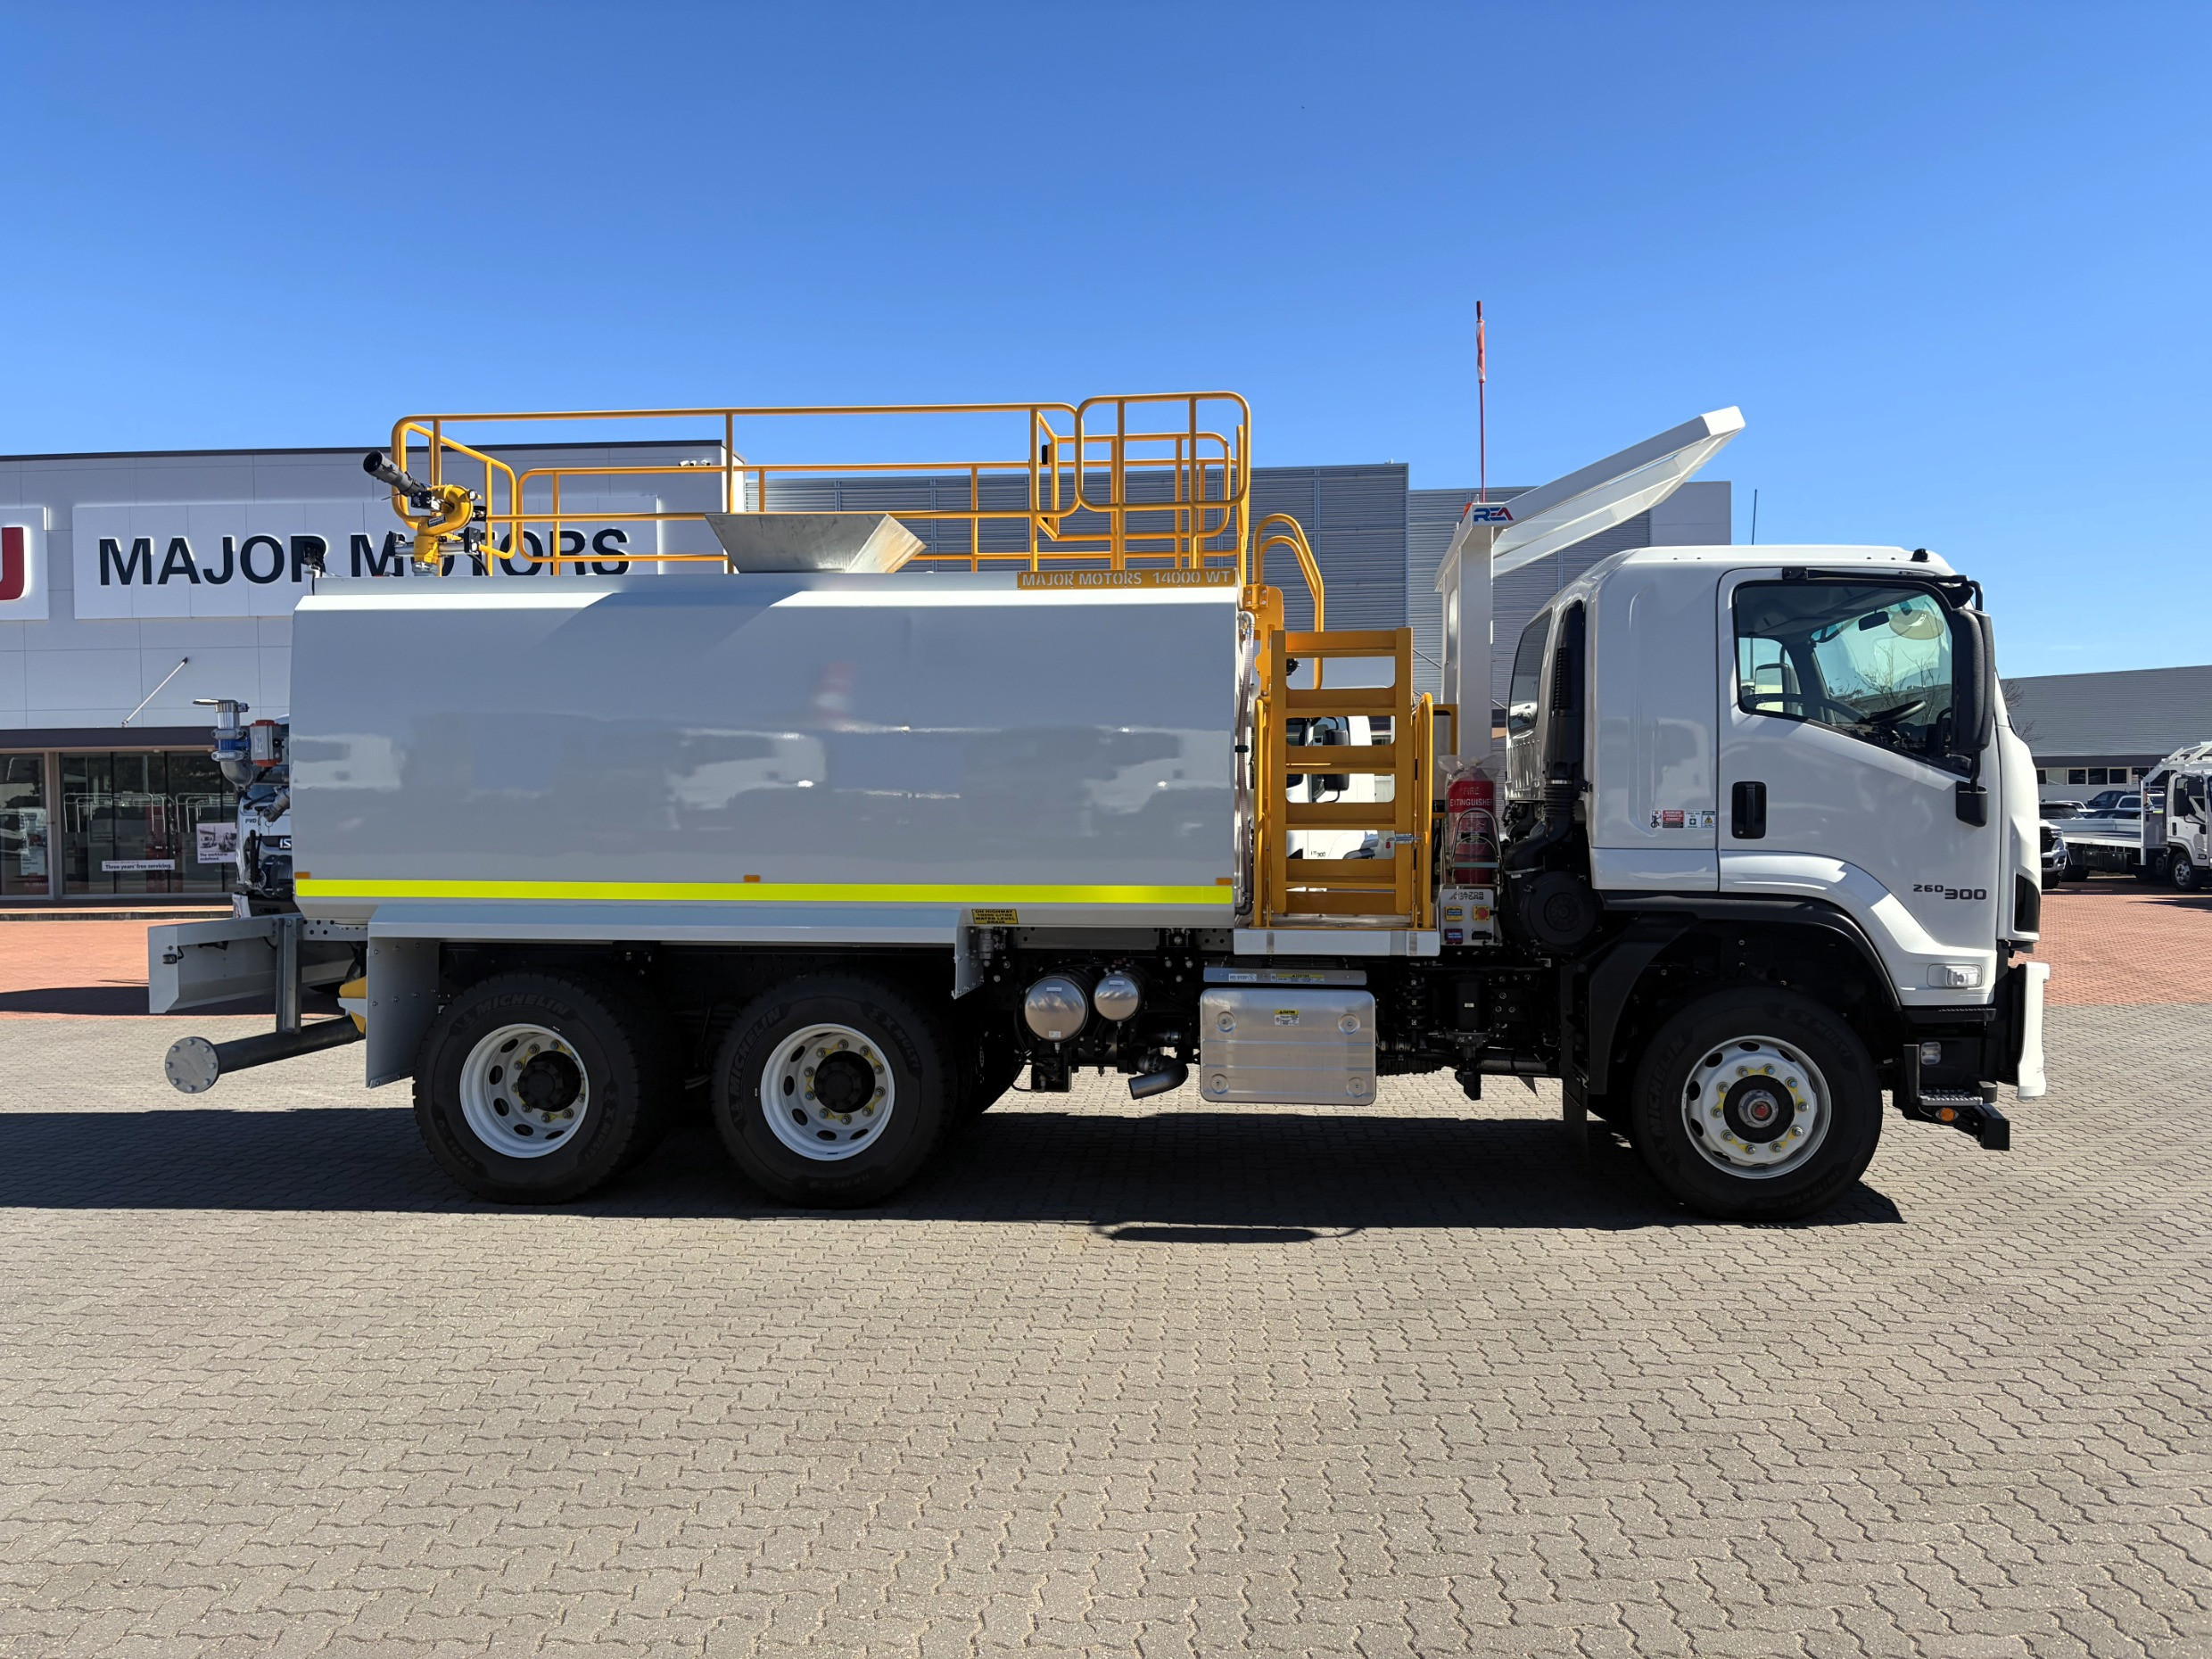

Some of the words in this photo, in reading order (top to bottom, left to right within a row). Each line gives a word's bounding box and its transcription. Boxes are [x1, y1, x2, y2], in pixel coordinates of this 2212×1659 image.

[1473, 507, 1514, 522] REA
[99, 535, 326, 585] MAJOR
[1022, 574, 1073, 586] MAJOR
[1079, 572, 1143, 585] MOTORS
[1152, 572, 1201, 584] 14000
[1206, 571, 1230, 583] WT
[1463, 787, 1481, 796] FIRE
[1913, 884, 1944, 893] 260
[1944, 888, 1987, 900] 300
[475, 993, 570, 1017] MICHELIN
[729, 1006, 780, 1096] MICHELIN
[1647, 1033, 1687, 1140] MICHELIN
